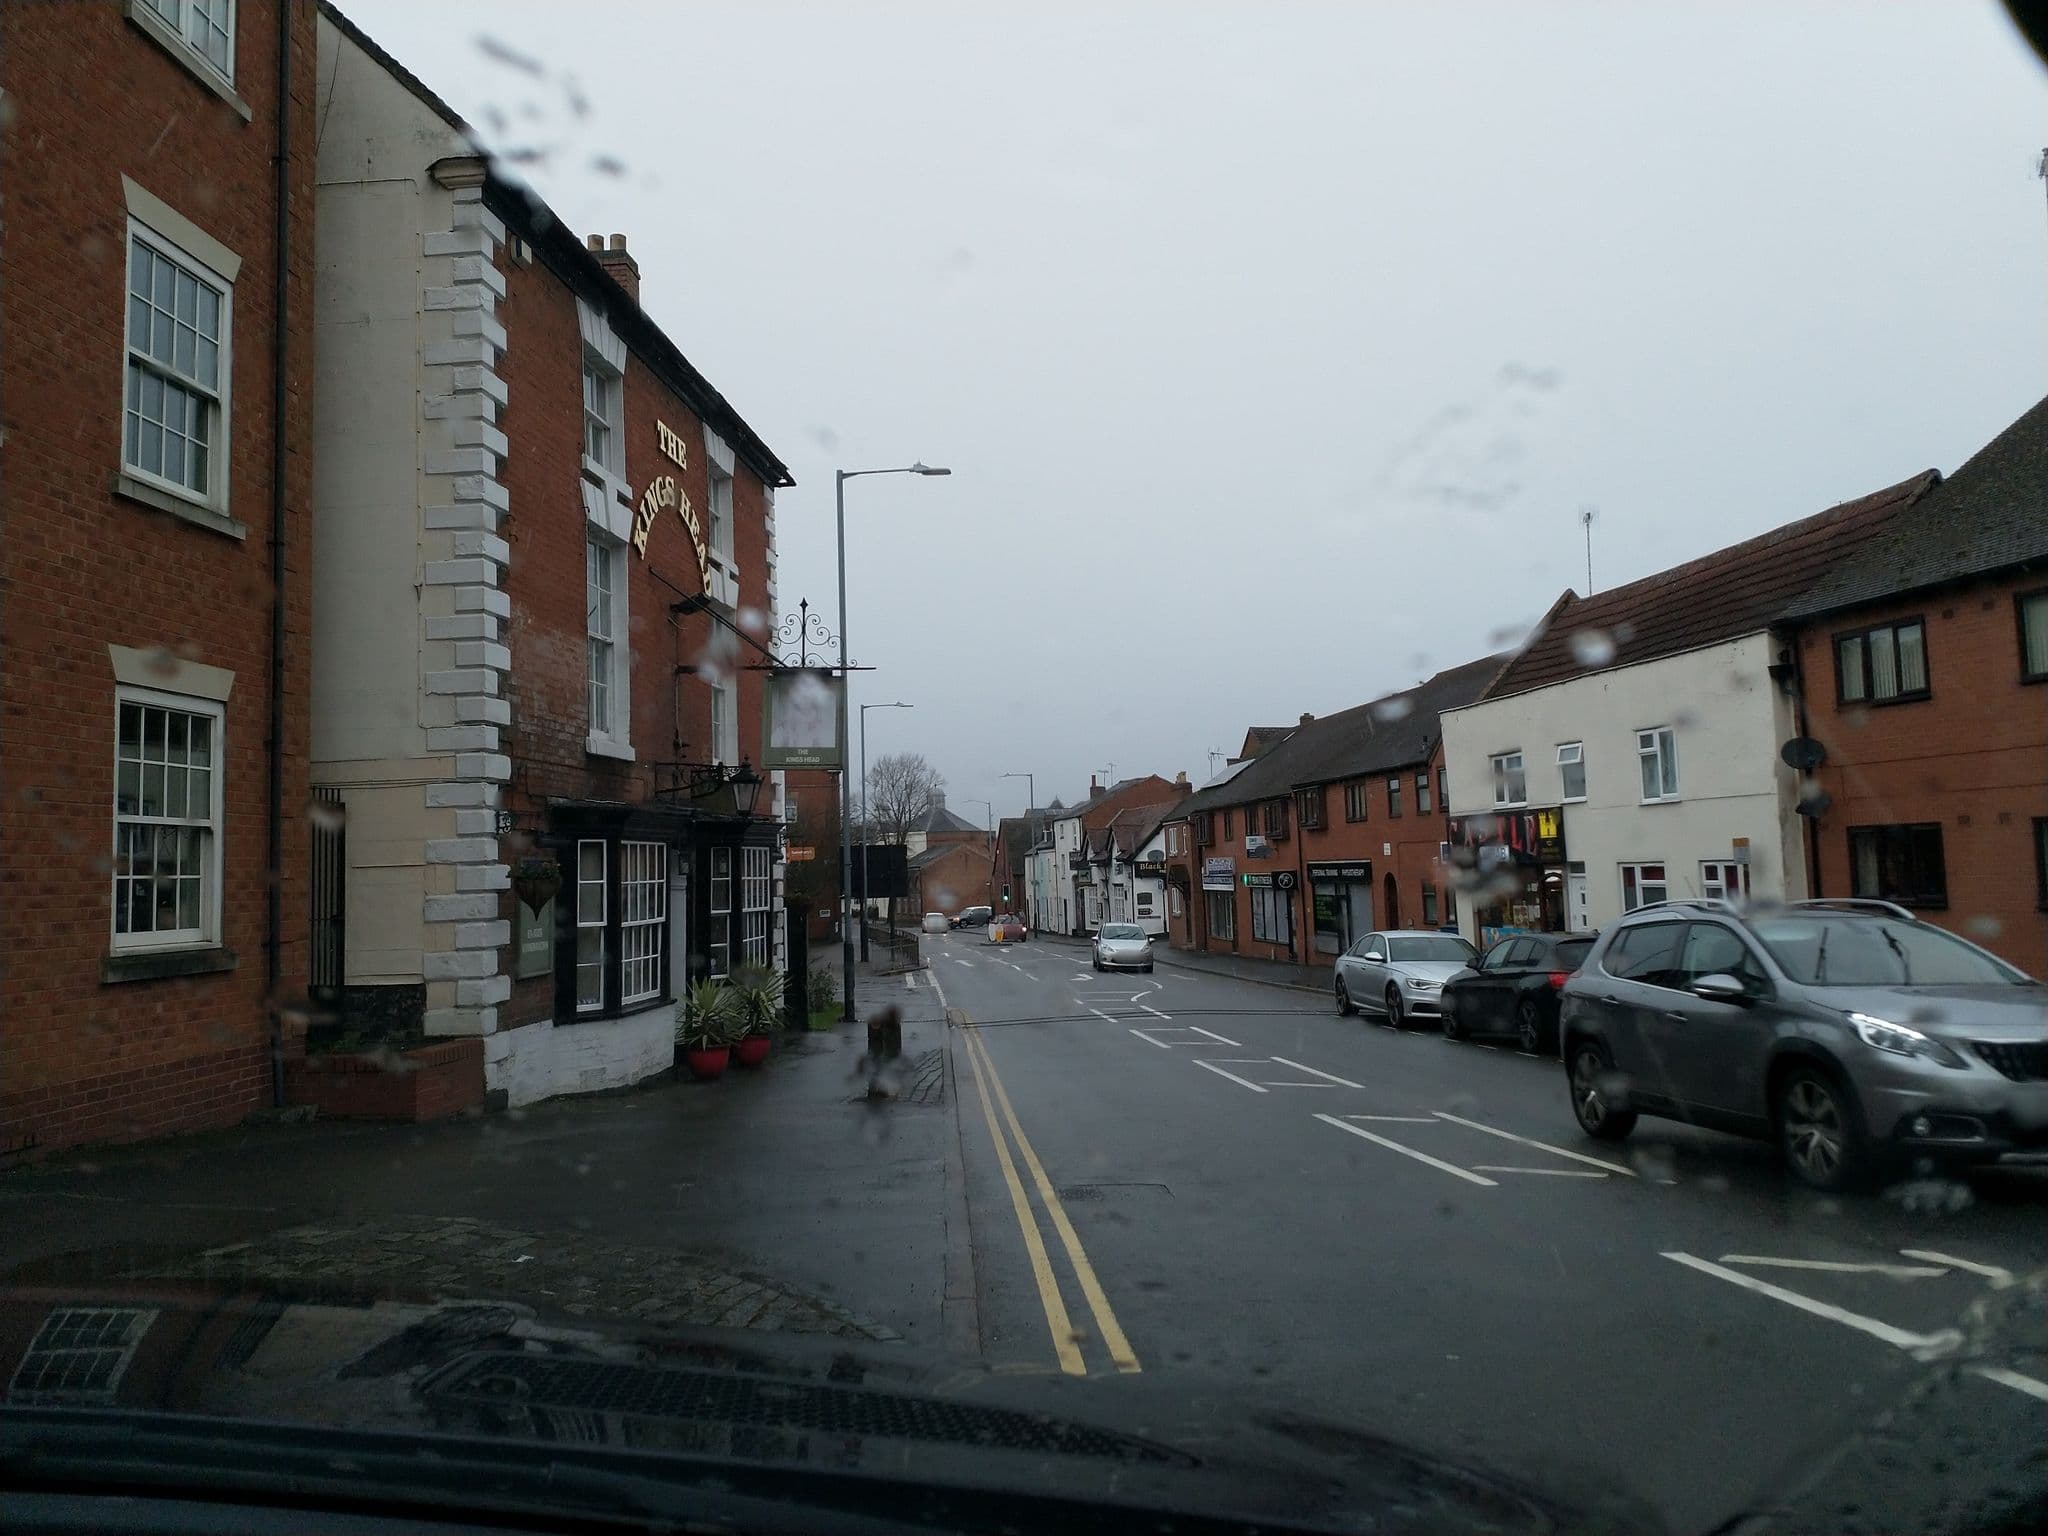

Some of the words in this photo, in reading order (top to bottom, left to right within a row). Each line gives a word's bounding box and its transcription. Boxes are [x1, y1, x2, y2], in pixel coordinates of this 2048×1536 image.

[657, 419, 687, 471] THE
[634, 476, 675, 560] KINGS
[679, 488, 712, 597] HEAD
[1140, 862, 1162, 870] Black
